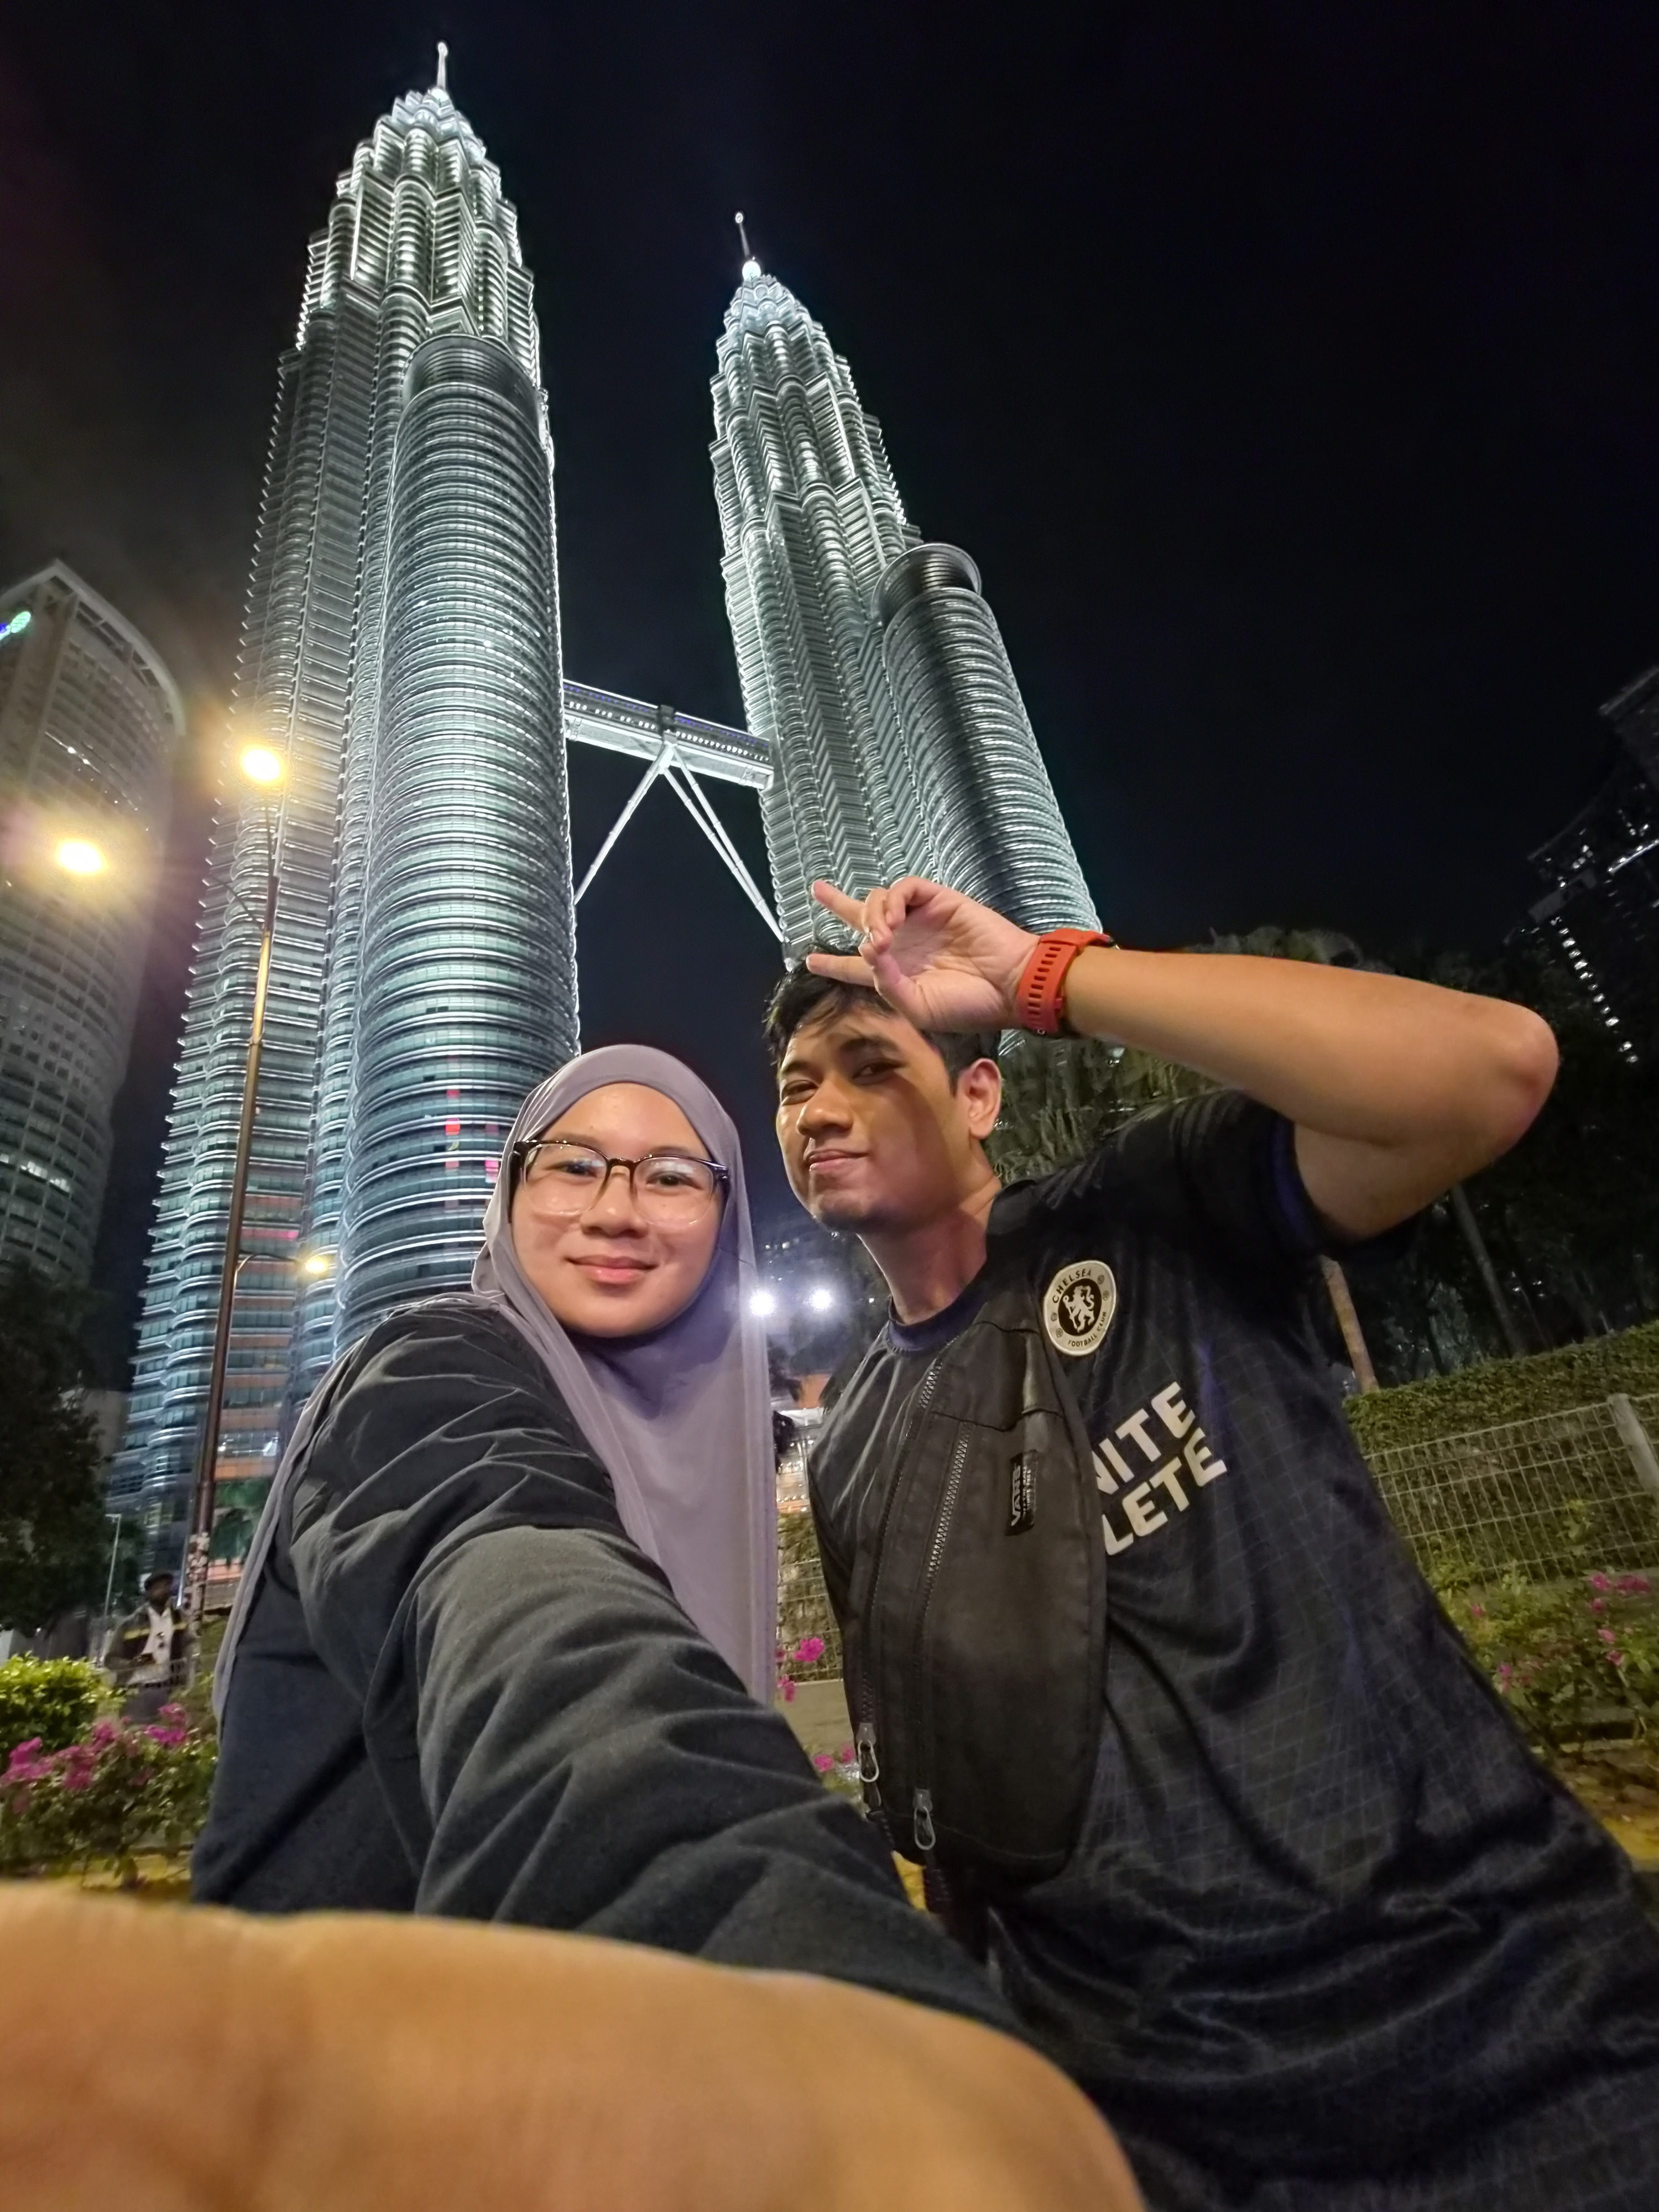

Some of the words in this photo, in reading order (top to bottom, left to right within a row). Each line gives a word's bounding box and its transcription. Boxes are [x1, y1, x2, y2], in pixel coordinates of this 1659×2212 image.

[1052, 1269, 1092, 1303] CHELSEA
[1068, 1333, 1097, 1347] FOOTBALL
[1097, 1312, 1107, 1332] CLUB
[1011, 1463, 1021, 1526] VANS
